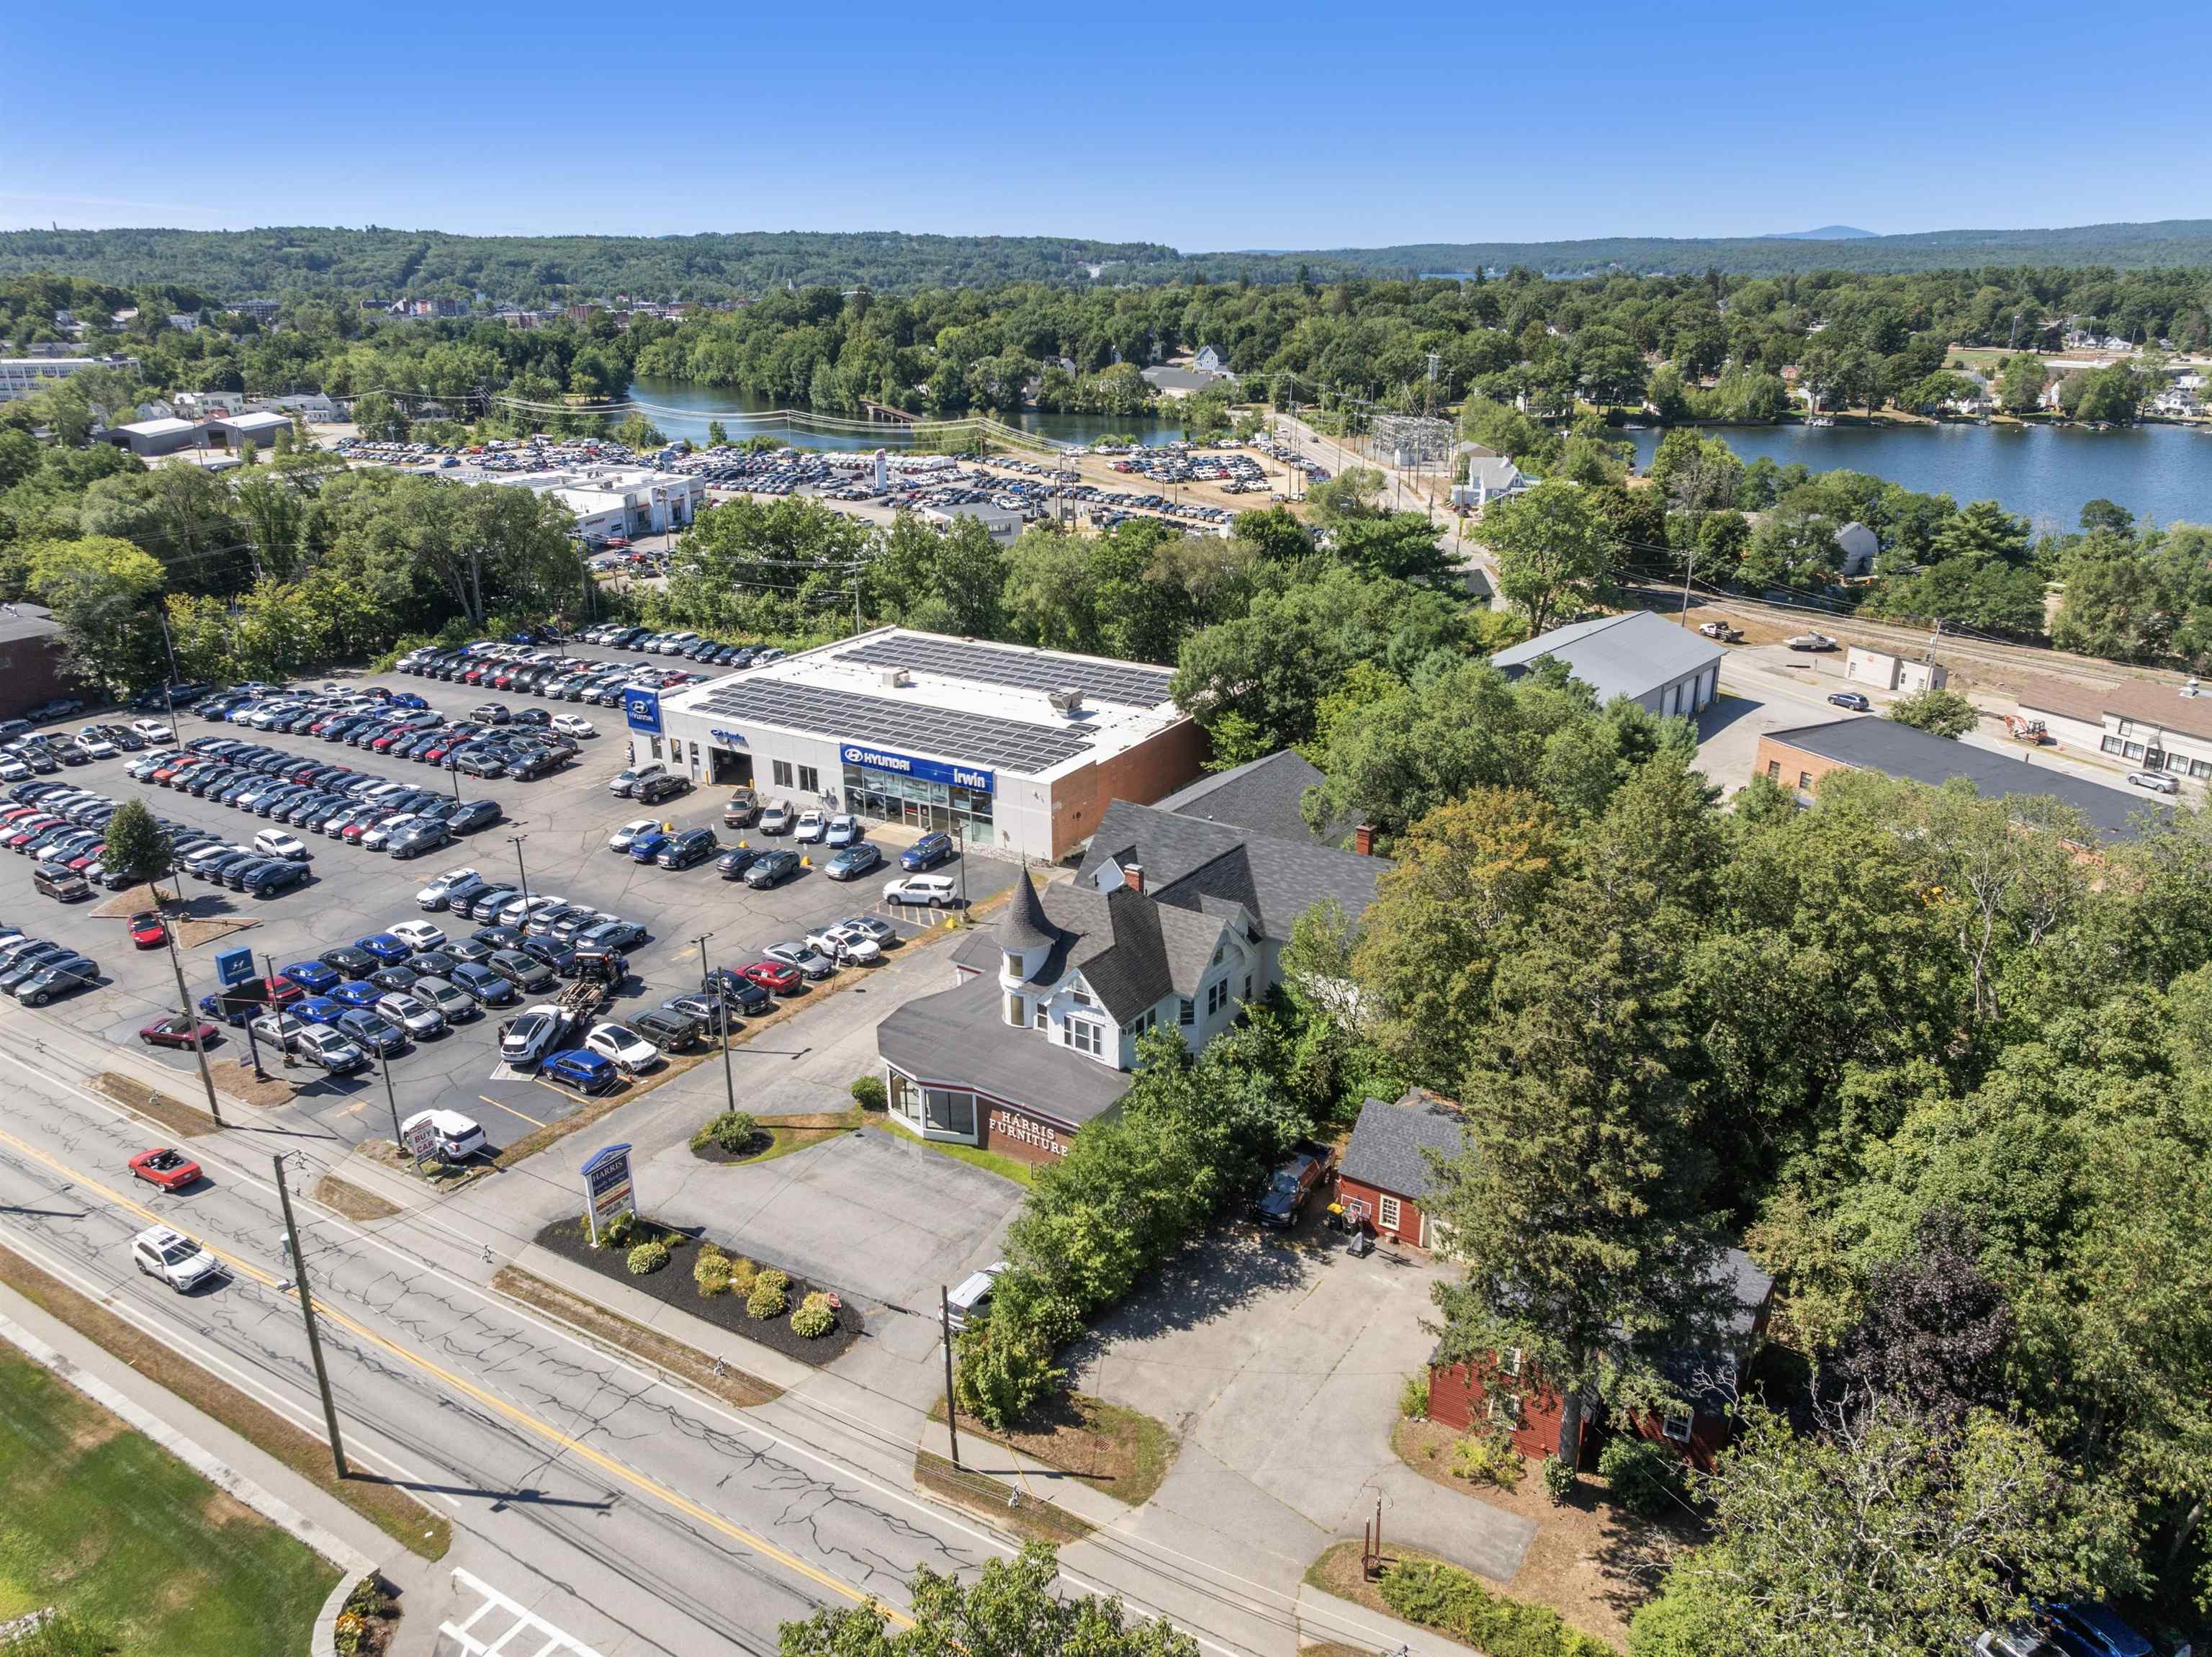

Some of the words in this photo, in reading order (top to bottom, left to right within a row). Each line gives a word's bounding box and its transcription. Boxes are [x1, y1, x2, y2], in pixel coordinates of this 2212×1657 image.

[863, 753, 911, 771] HYUNDAI
[1002, 1111, 1054, 1139] HARRIS
[415, 1129, 431, 1144] BUY
[989, 1118, 1069, 1157] FURNITURE
[417, 1140, 433, 1153] CAR
[593, 1160, 624, 1181] HARRIS
